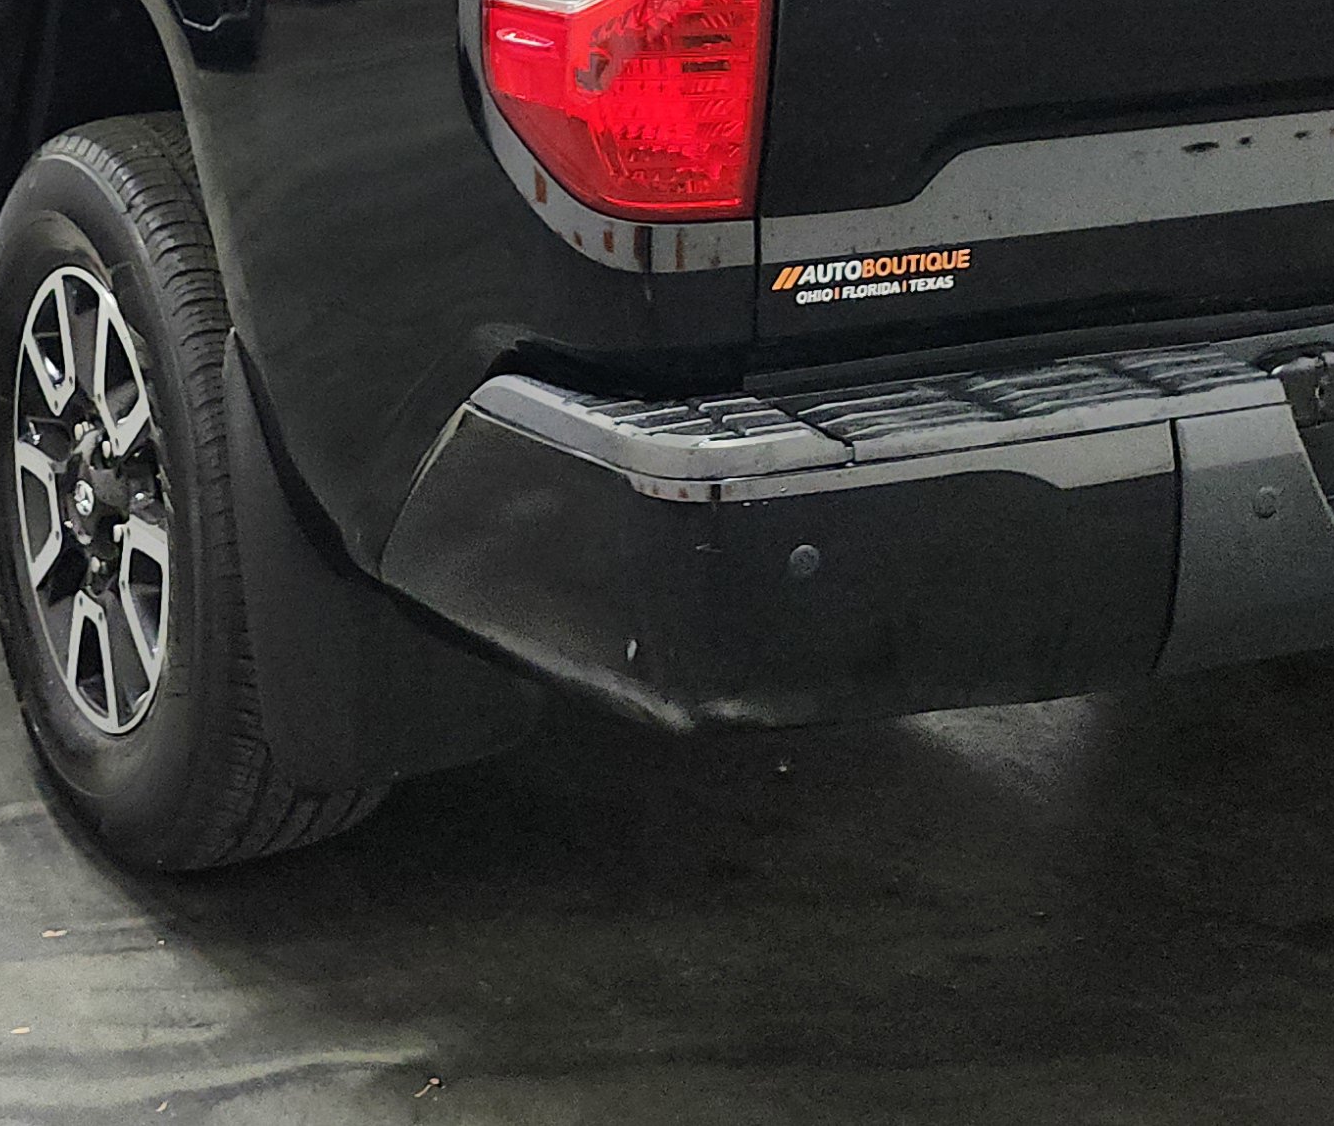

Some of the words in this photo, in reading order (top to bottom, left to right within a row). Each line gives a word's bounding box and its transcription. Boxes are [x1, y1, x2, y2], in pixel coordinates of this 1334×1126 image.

[797, 248, 971, 285] AUTOBOUTIQUE
[795, 287, 834, 305] OHIO
[841, 283, 901, 300] FLORIDA
[909, 274, 955, 293] TEXAS
